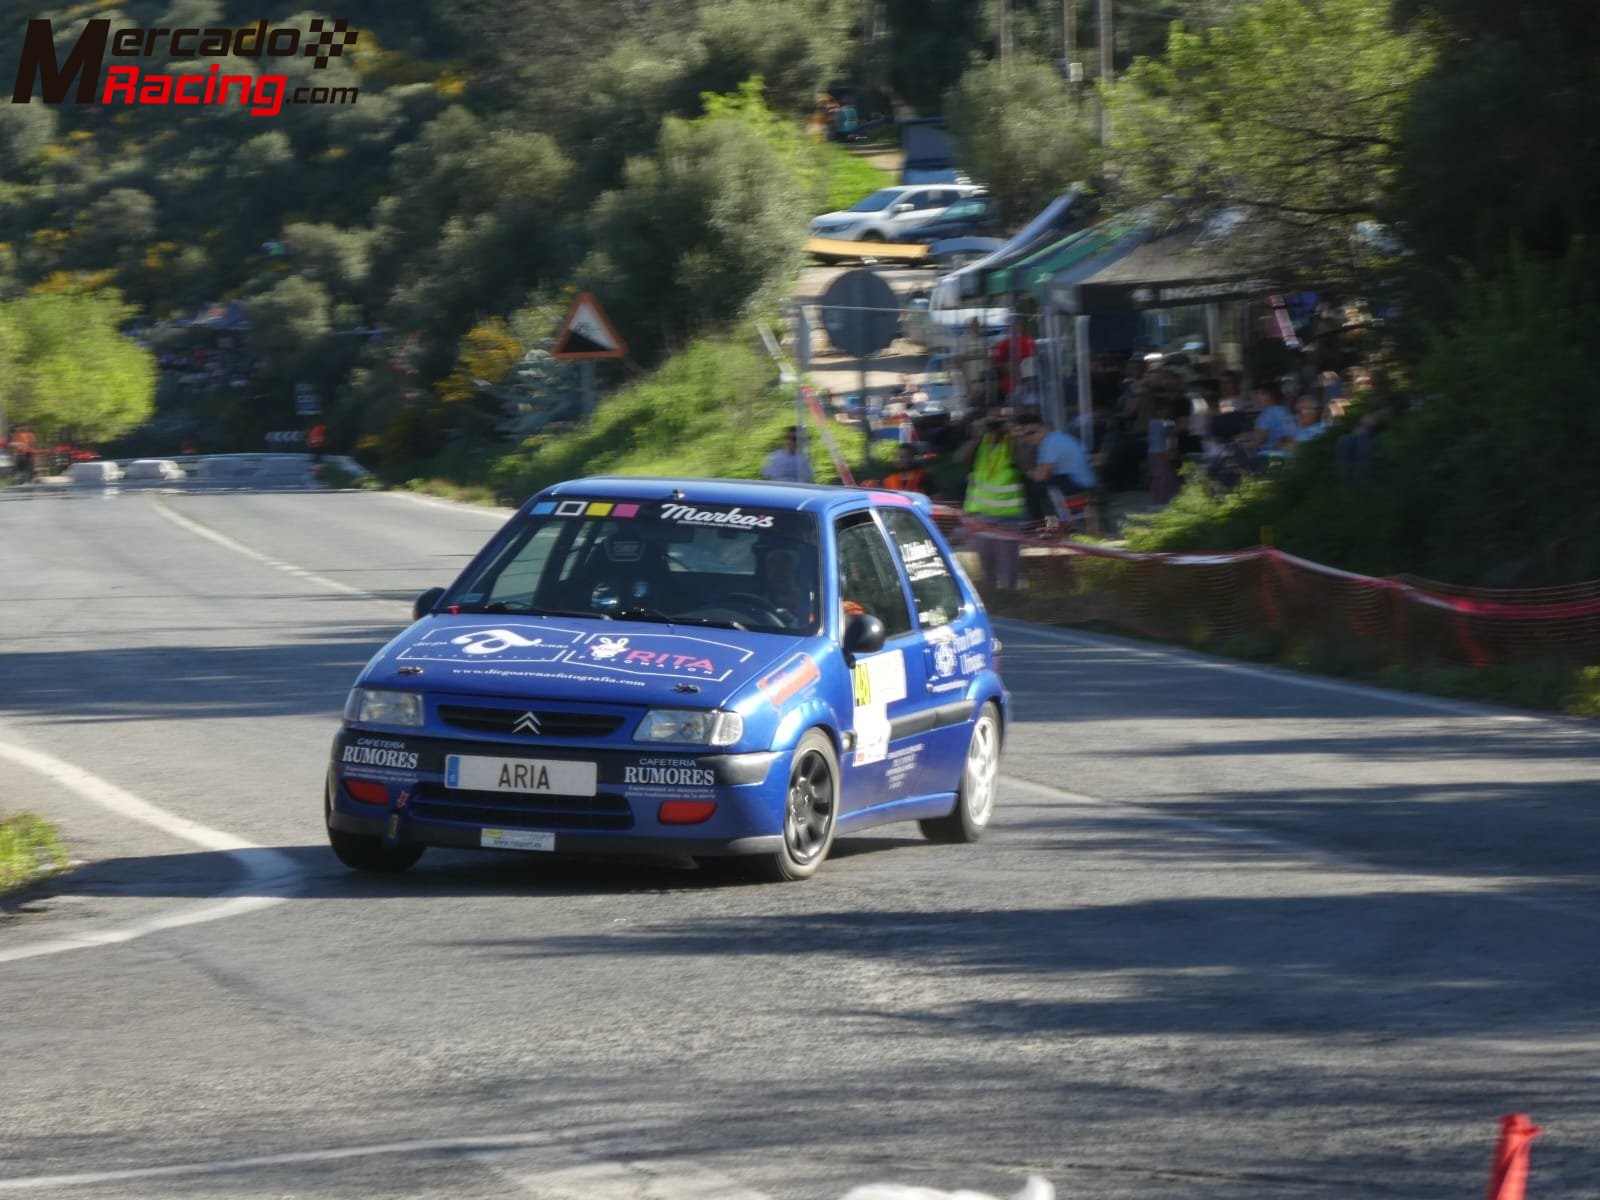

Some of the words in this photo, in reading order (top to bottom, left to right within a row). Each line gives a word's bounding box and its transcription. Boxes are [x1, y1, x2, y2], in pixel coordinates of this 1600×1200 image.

[624, 650, 715, 672] RITA
[452, 668, 646, 687] www.diegoarenasfotografia.com
[356, 738, 406, 750] CAFETERIA
[342, 745, 419, 770] RUMORES
[639, 758, 697, 768] CAFETERIA
[498, 763, 550, 790] ARIA
[624, 766, 715, 786] RUMORES
